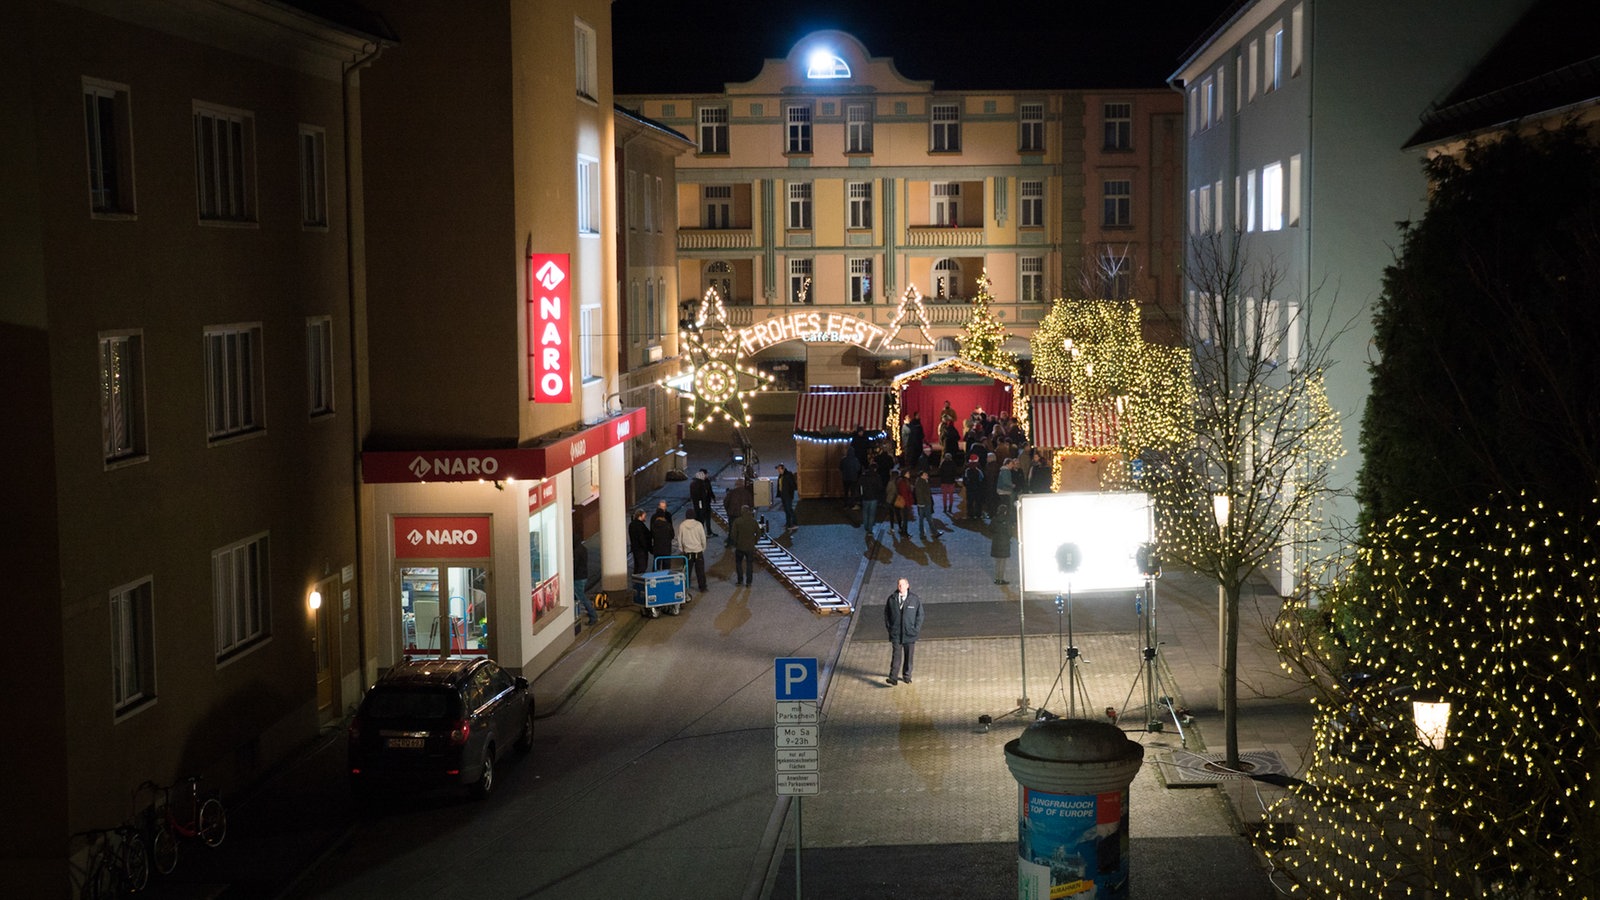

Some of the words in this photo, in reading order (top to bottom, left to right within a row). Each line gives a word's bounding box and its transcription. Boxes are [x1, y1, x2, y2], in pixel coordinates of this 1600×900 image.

[743, 312, 821, 351] FROHES
[827, 313, 883, 348] FEST
[540, 297, 564, 397] NARO
[574, 439, 587, 459] NARO
[434, 456, 498, 476] NARO
[426, 529, 477, 545] NARO
[785, 663, 808, 695] P
[778, 712, 815, 720] Parkschein
[799, 728, 810, 736] Sa
[785, 737, 809, 745] 9-23h
[1031, 798, 1094, 809] JUNGFRAUJOCH
[1031, 805, 1043, 814] TOP
[1046, 808, 1057, 816] OF
[1059, 809, 1094, 817] EUROPE
